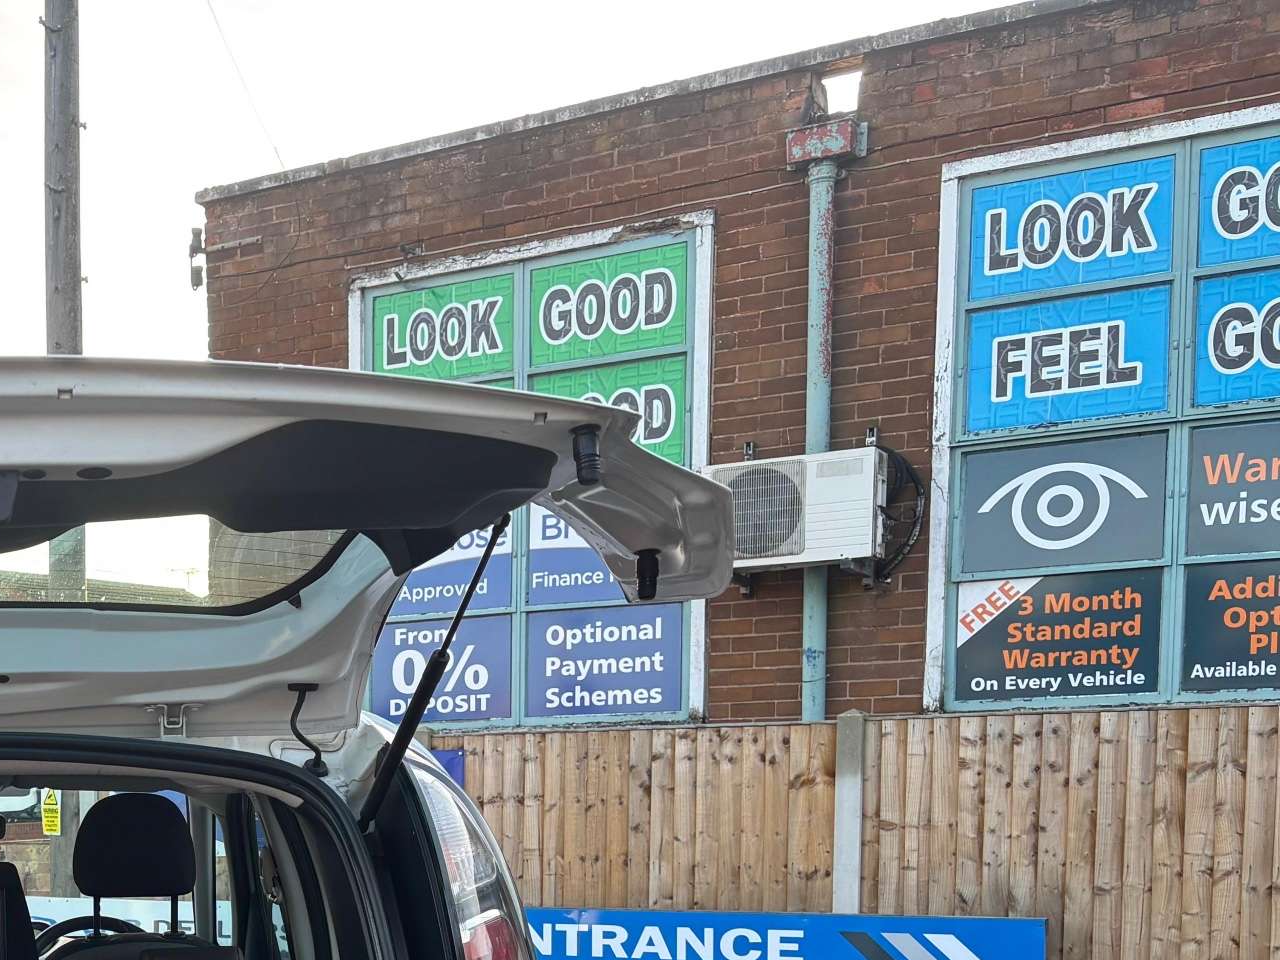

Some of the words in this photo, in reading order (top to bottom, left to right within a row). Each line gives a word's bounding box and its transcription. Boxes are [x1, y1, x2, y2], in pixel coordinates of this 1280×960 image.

[984, 183, 1158, 276] LOOK
[540, 268, 676, 344] GOOD
[383, 296, 503, 369] LOOK
[991, 320, 1142, 403] FEEL
[398, 579, 487, 603] Approvd
[532, 570, 604, 588] Finance
[1208, 575, 1280, 601] Add
[959, 580, 1021, 635] FREE
[1018, 596, 1034, 616] 3
[1044, 587, 1142, 614] Month
[545, 617, 662, 650] Optional
[1007, 614, 1141, 644] Standard
[392, 645, 489, 695] 0%
[545, 651, 664, 681] Payment
[1002, 646, 1140, 670] Warranty
[1190, 660, 1277, 678] Available
[970, 677, 998, 692] On
[1005, 673, 1062, 692] Every
[1068, 670, 1146, 687] Vehicle
[390, 694, 491, 716] DPOSIT
[545, 686, 663, 708] Schemes
